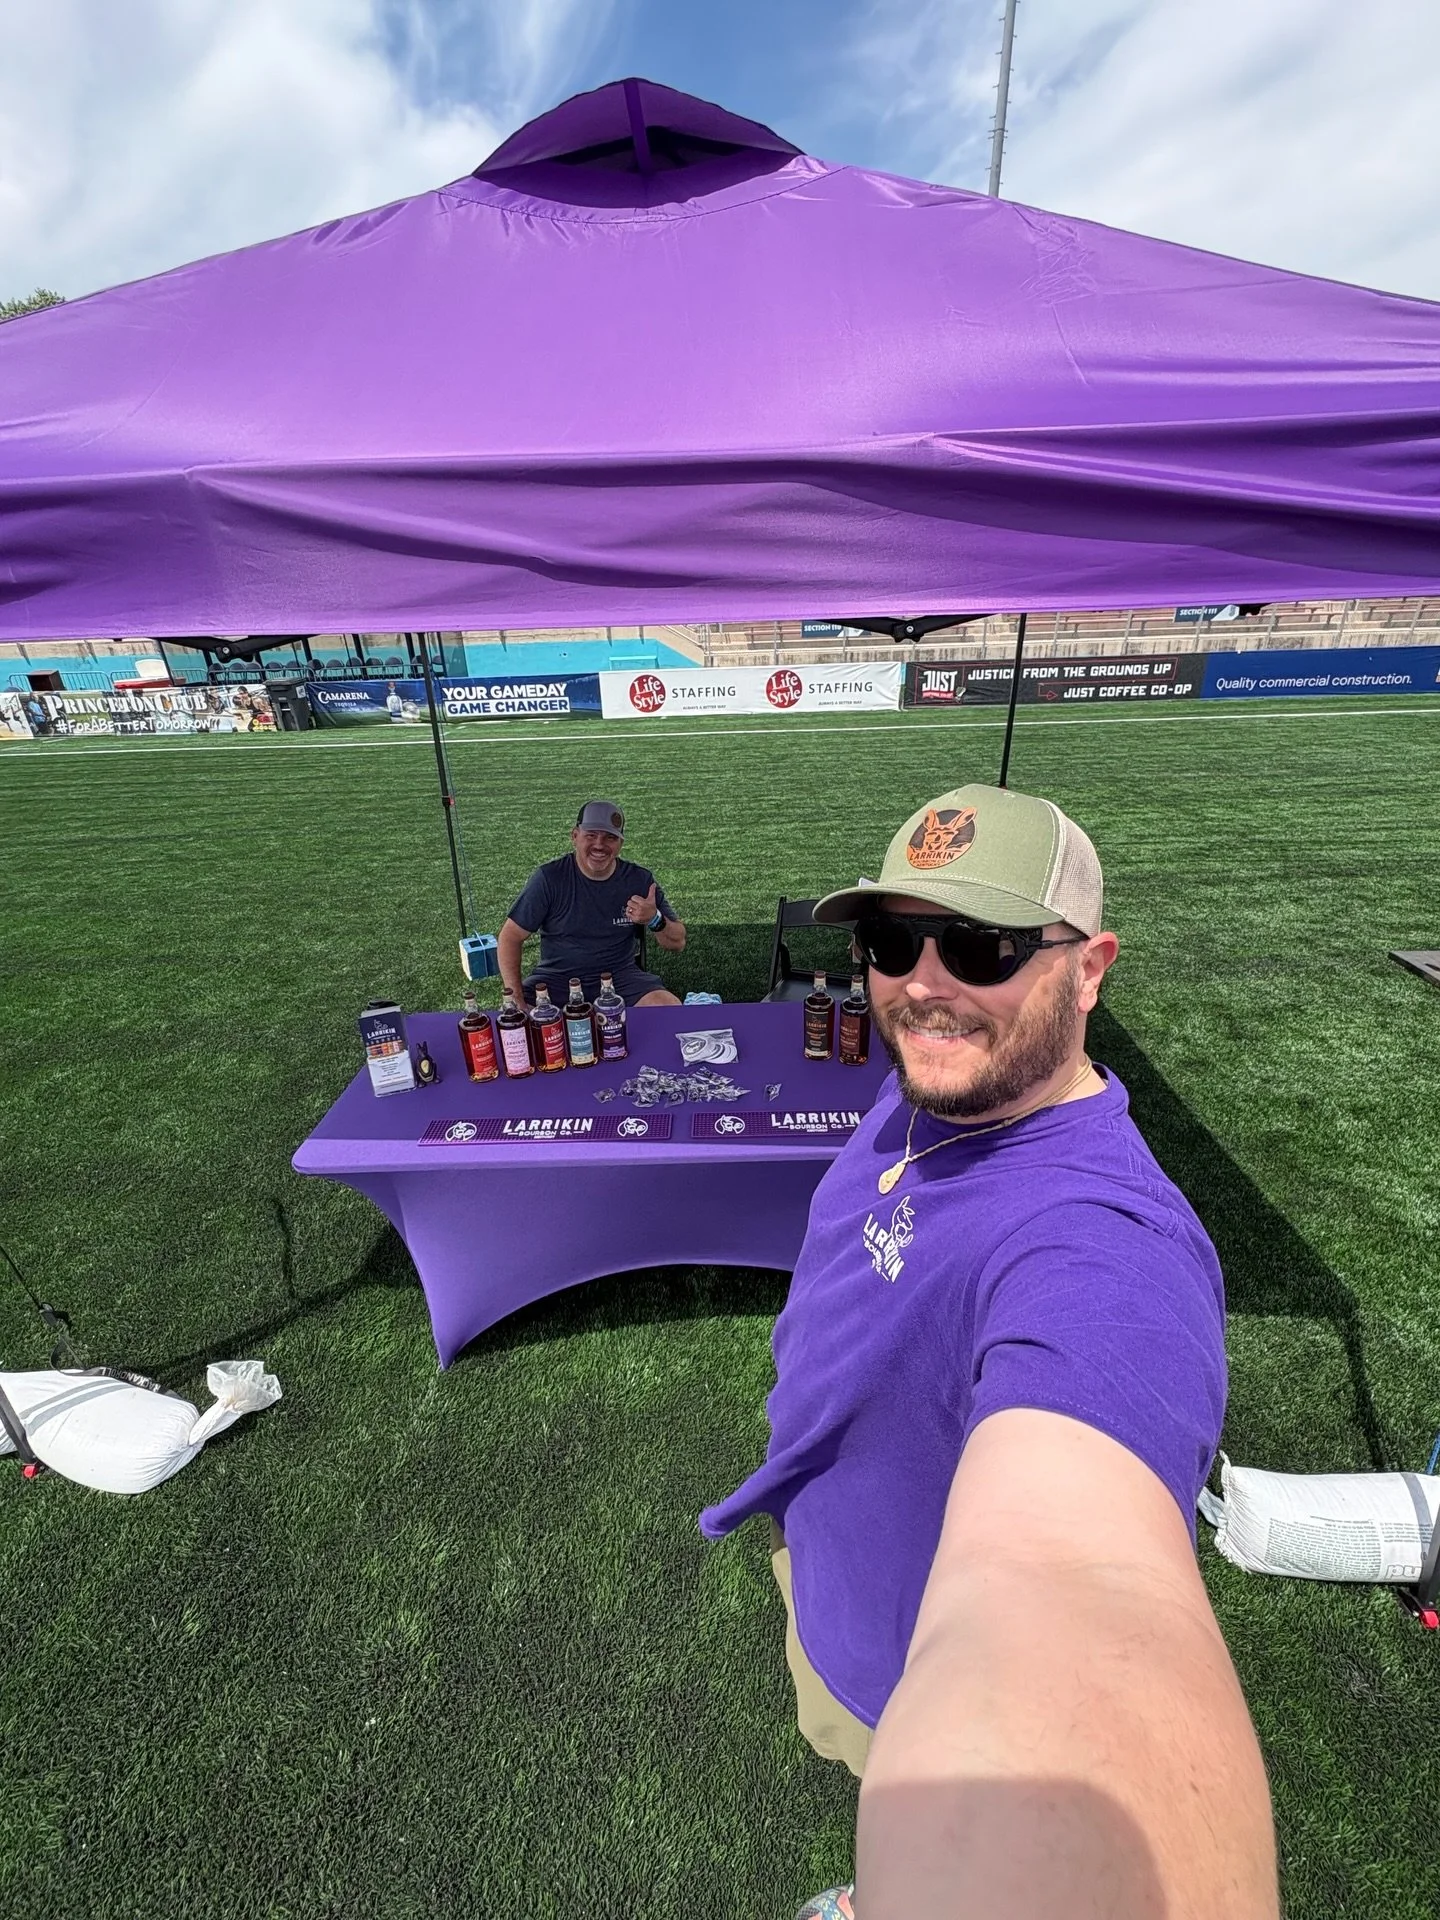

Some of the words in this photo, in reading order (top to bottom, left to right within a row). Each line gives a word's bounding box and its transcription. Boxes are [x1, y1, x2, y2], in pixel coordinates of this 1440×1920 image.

[804, 624, 831, 632] SECTION
[1023, 667, 1059, 679] FROM
[1063, 666, 1087, 677] THE
[1090, 664, 1150, 676] GROUNDS
[1153, 663, 1172, 674] UP
[633, 677, 661, 695] Life
[771, 672, 799, 690] Life
[808, 681, 873, 694] STAFFING
[922, 670, 957, 692] JUST
[1216, 677, 1257, 691] Quality
[1259, 674, 1331, 687] commercial
[1332, 673, 1412, 686] construction.
[317, 691, 370, 704] CAMARENA
[442, 687, 488, 700] YOUR
[490, 683, 567, 698] GAMEDAY
[672, 686, 736, 698] STAFFING
[770, 686, 801, 706] Style
[1063, 687, 1095, 698] JUST
[1099, 685, 1147, 697] COFFEE
[1150, 683, 1192, 695] CO-OP
[447, 702, 492, 714] GAME
[495, 700, 569, 713] CHANGER
[633, 691, 665, 710] Style
[910, 852, 955, 861] LARRIKIN
[503, 1118, 593, 1133] LARRIKIN
[771, 1112, 861, 1127] LARRIKIN
